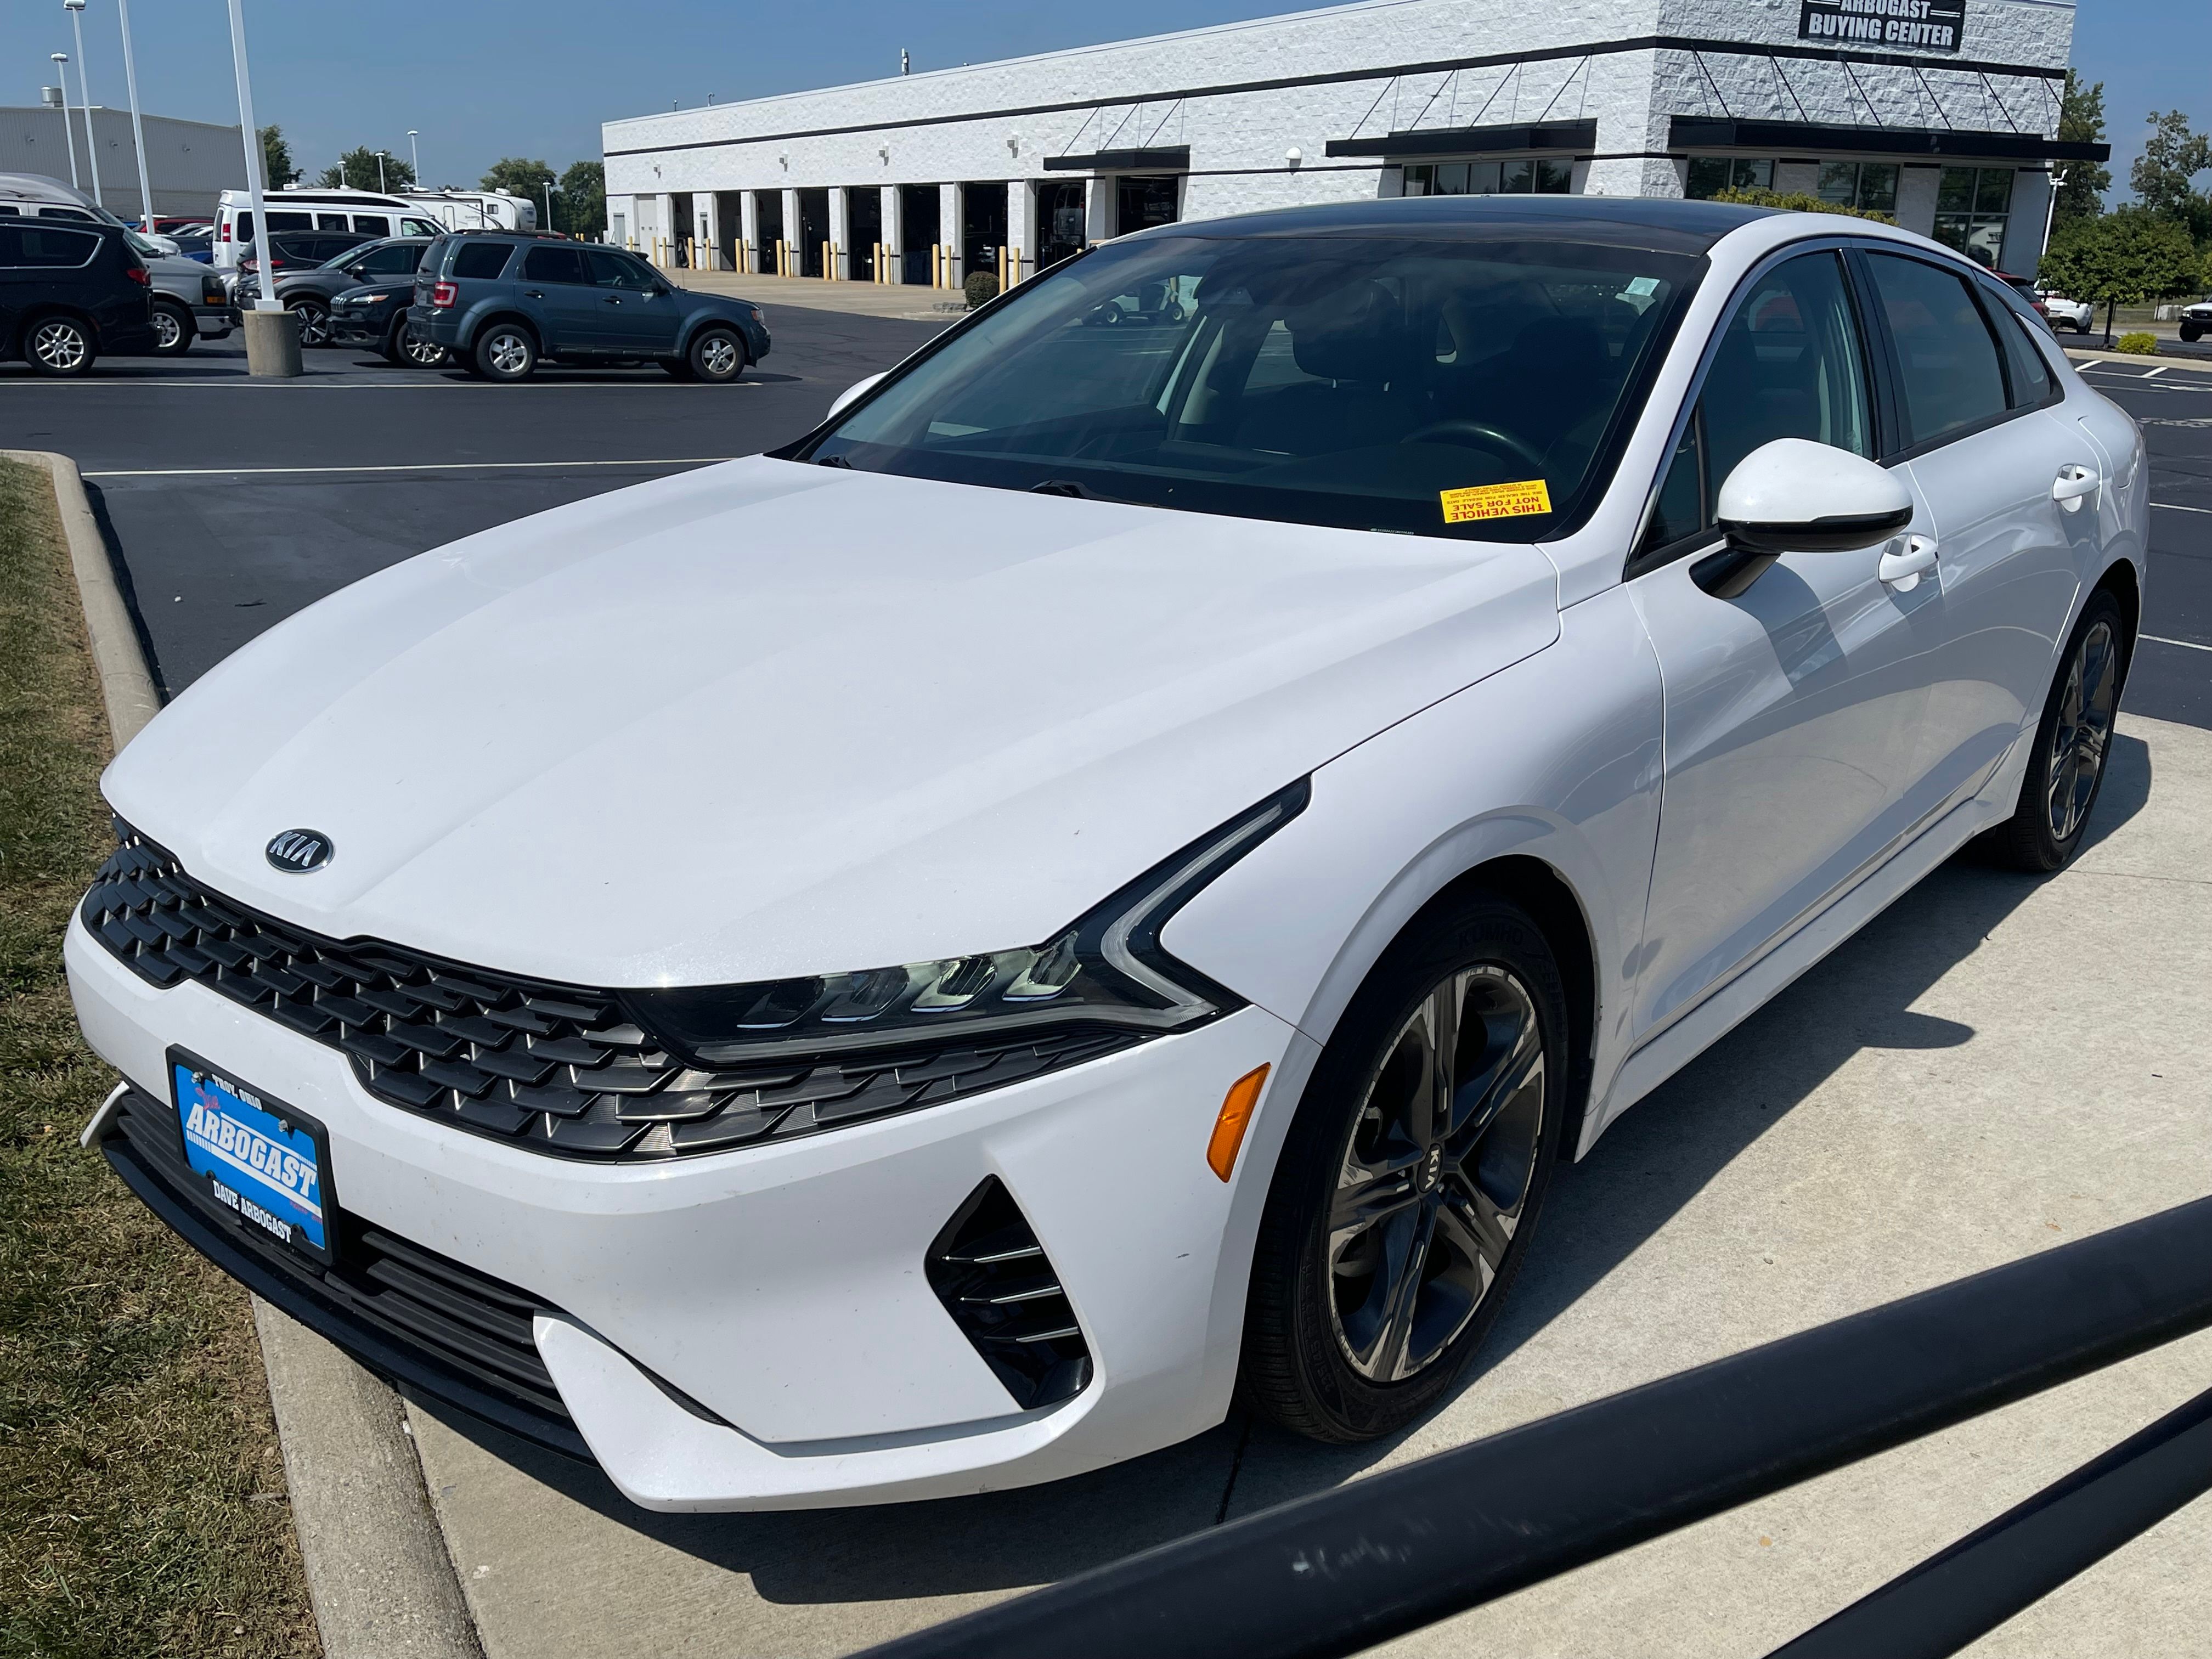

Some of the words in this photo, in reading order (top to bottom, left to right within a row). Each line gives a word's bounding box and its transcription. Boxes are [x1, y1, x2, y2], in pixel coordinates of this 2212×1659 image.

[1840, 0, 1930, 19] ARBOGAST
[1808, 13, 1881, 40] BUYING
[1884, 20, 1953, 46] CENTER
[1451, 507, 1510, 520] VEHICLE
[1513, 504, 1544, 514] THIS
[269, 831, 320, 867] KIA
[212, 1074, 238, 1099] TROY,
[239, 1088, 263, 1111] OHIO
[187, 1103, 317, 1198] ARBOGAST
[1425, 1149, 1439, 1189] KIA
[213, 1180, 238, 1211] DAVE
[240, 1198, 292, 1243] ARBOGAST
